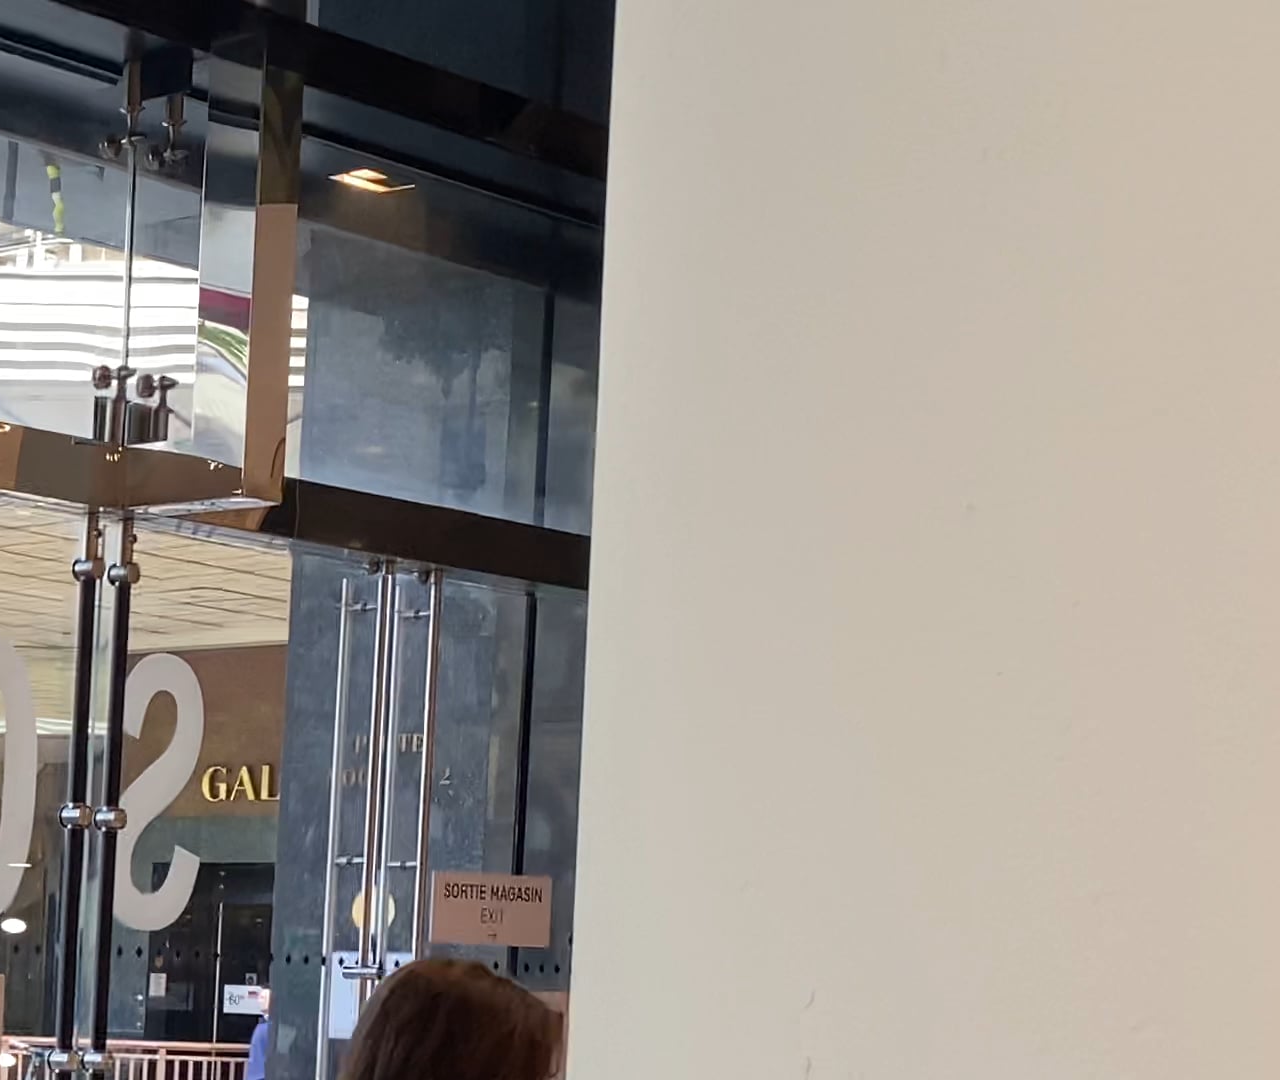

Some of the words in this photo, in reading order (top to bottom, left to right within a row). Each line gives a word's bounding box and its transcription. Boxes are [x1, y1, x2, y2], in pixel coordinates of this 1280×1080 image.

[201, 765, 280, 802] GAL
[444, 882, 486, 900] SORTIE
[490, 884, 543, 903] MAGASIN
[480, 907, 503, 924] EXIT
